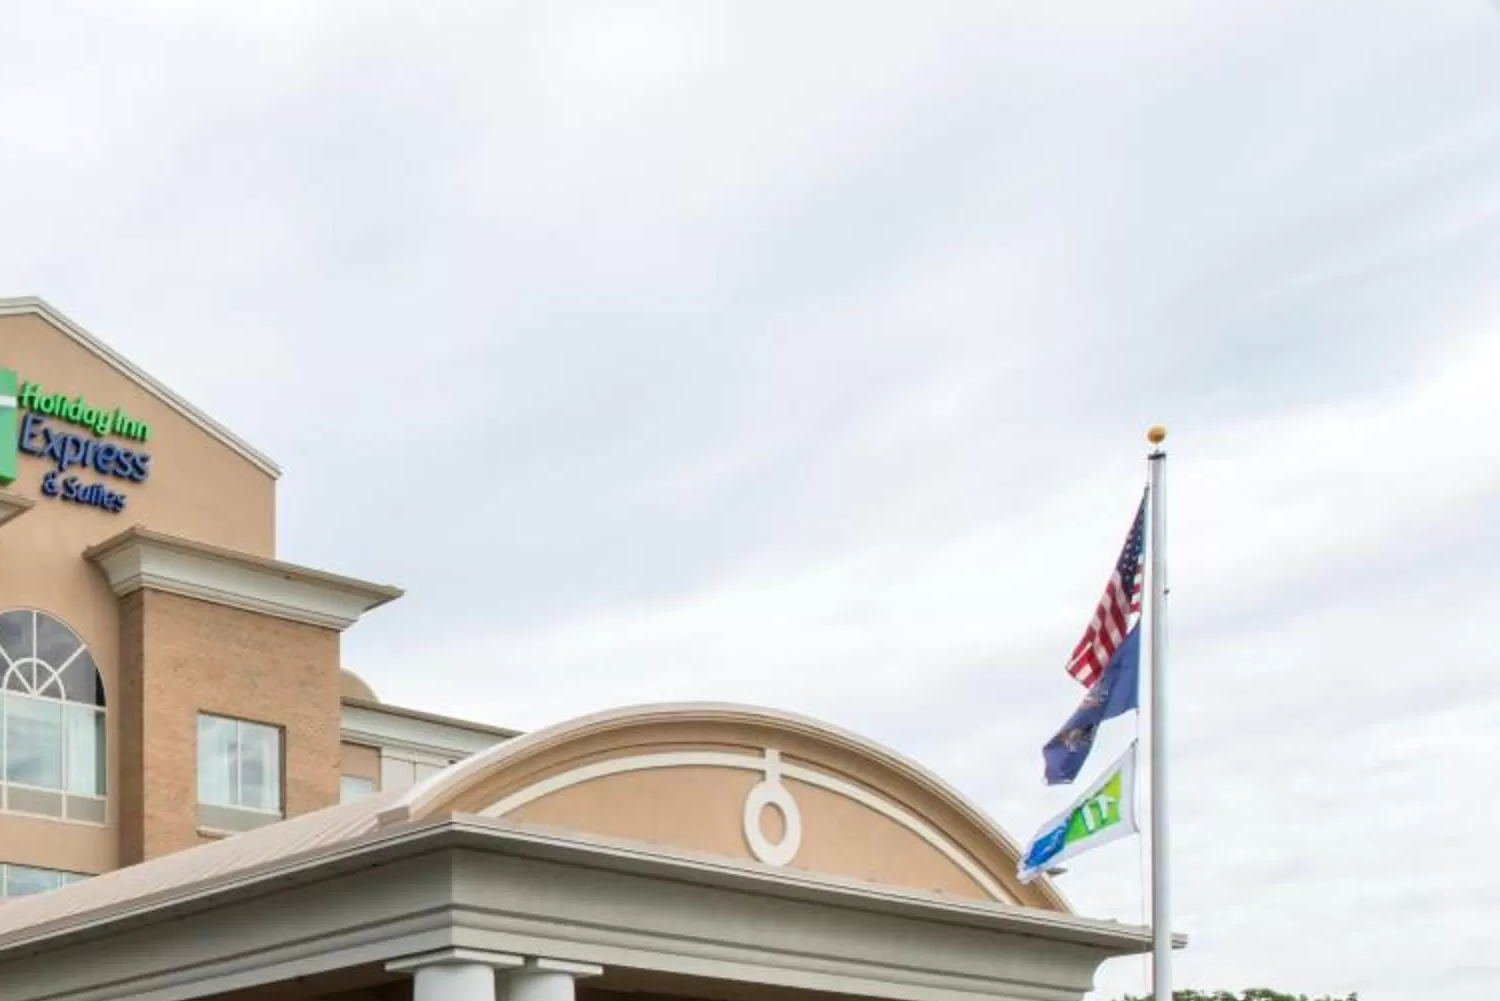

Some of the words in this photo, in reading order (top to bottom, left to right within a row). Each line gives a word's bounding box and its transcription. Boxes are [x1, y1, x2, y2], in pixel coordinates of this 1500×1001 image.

[18, 382, 112, 436] Holiday
[112, 408, 148, 441] Inn
[19, 411, 150, 483] Express
[41, 470, 60, 497] &
[60, 476, 127, 513] Suites
